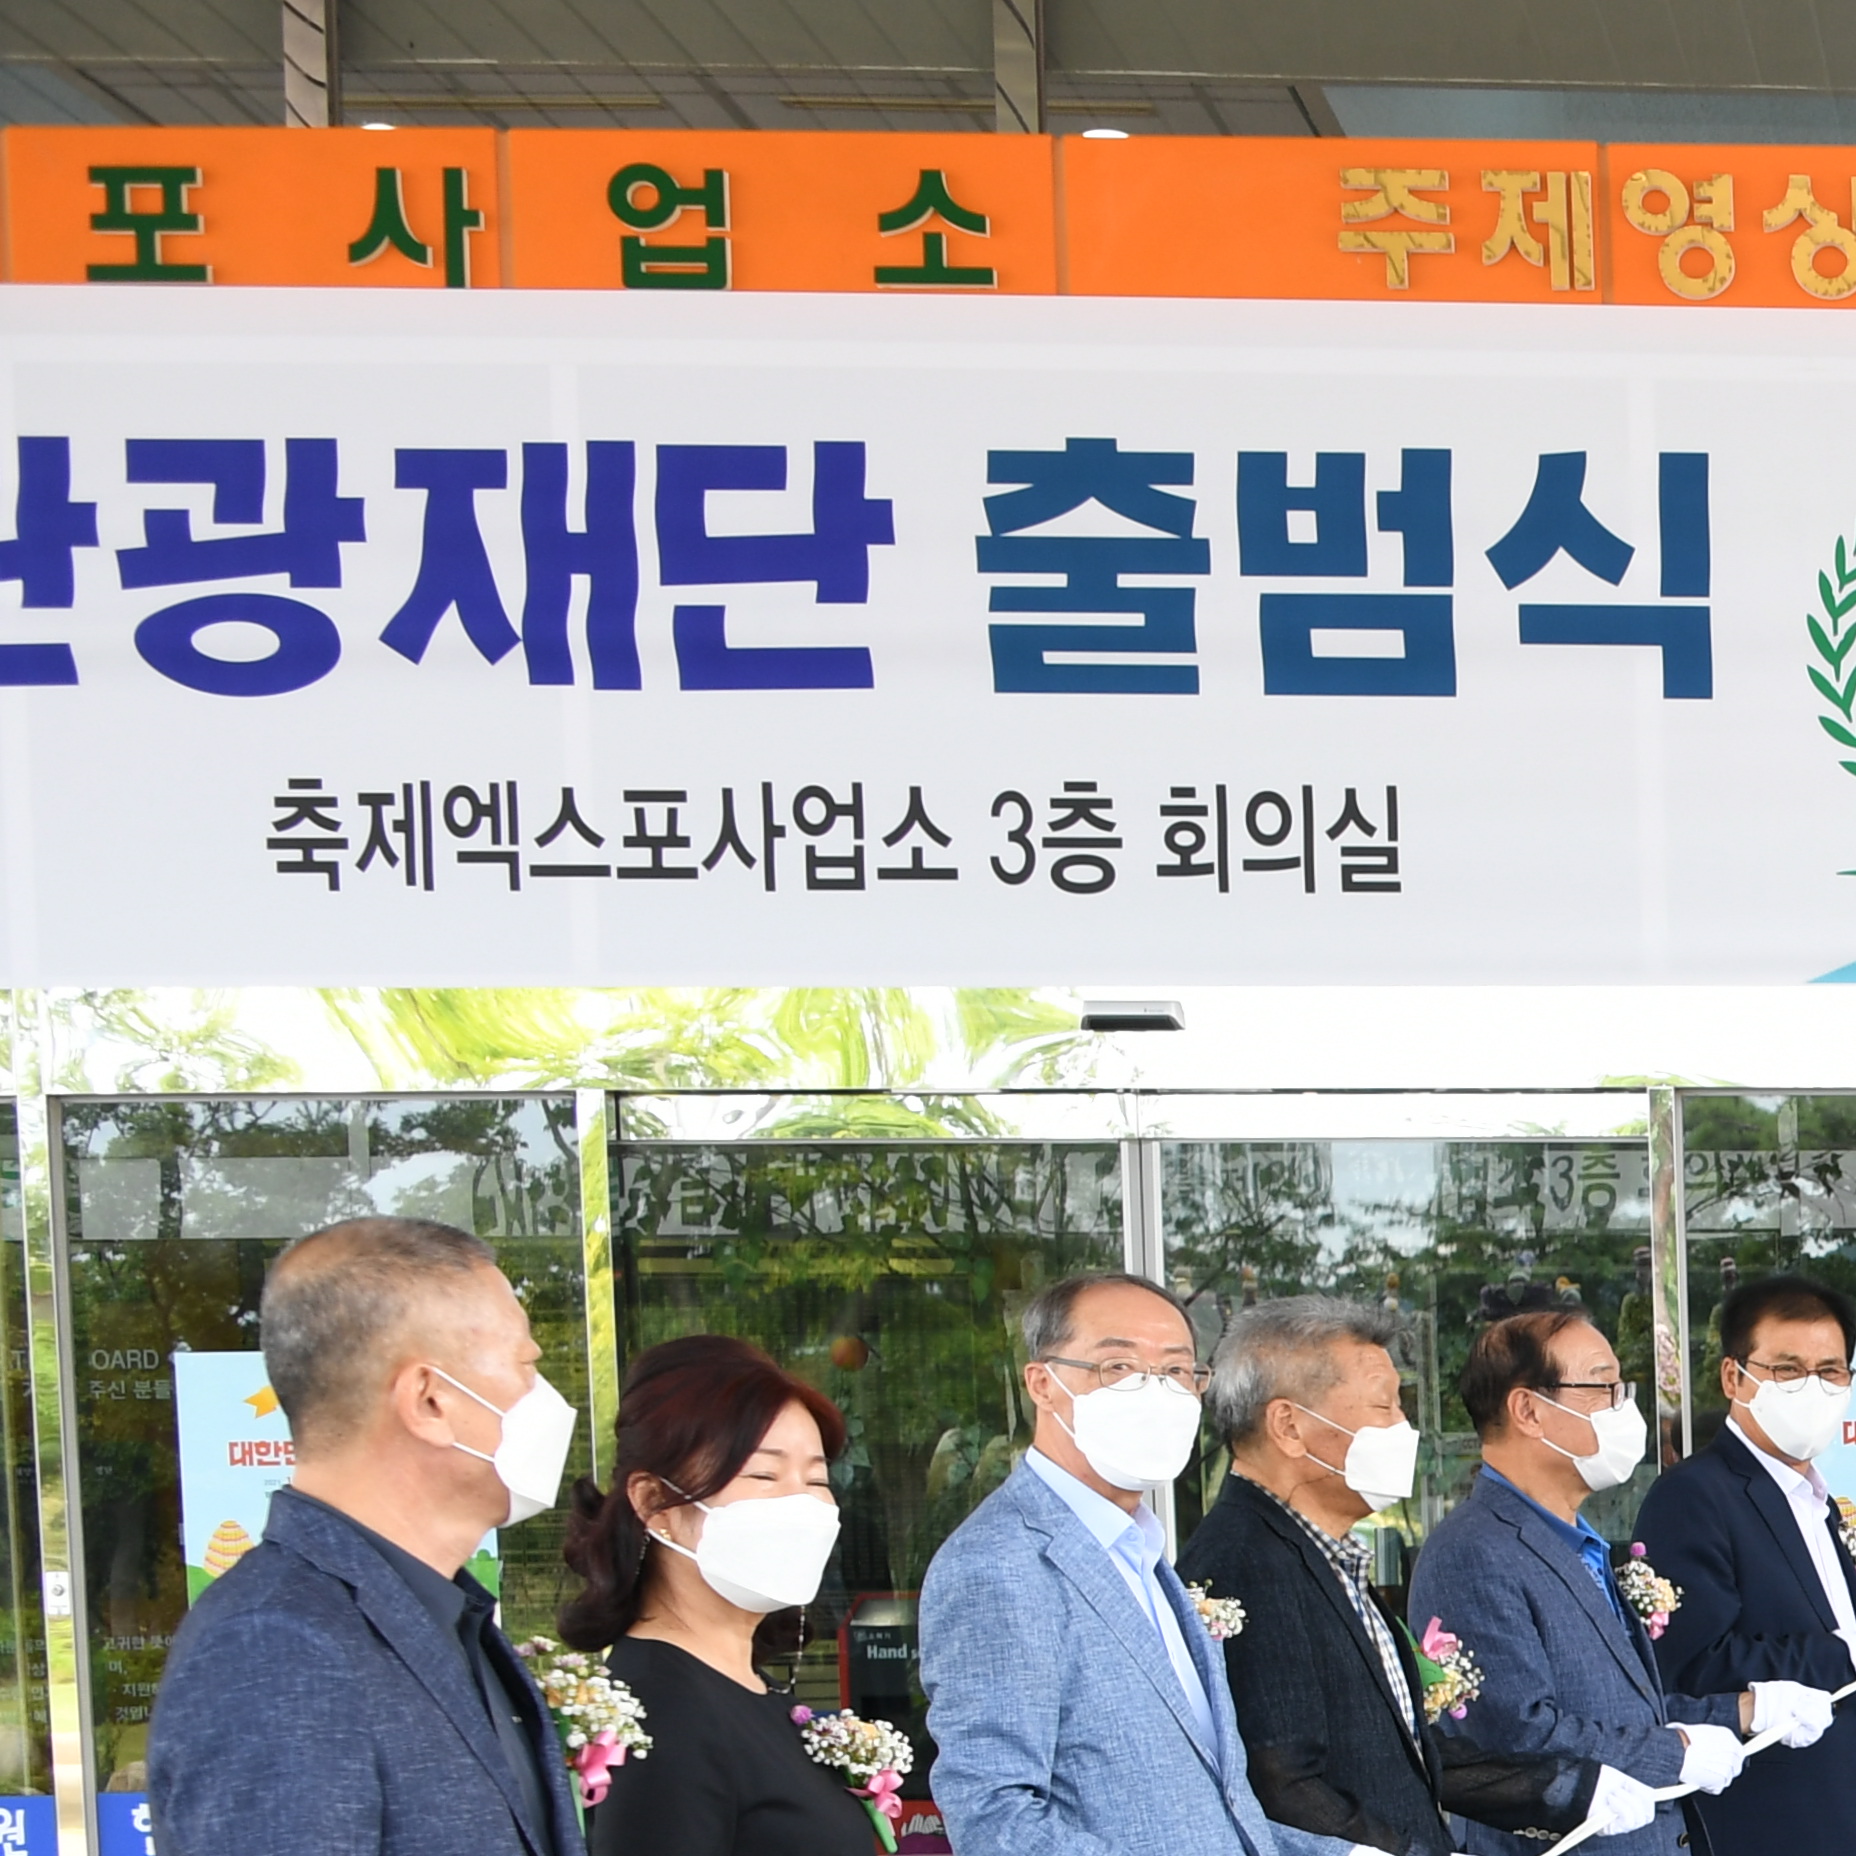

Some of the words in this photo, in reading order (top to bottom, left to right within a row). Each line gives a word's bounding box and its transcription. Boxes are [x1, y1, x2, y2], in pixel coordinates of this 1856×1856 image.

[975, 438, 1714, 700] 출범식
[265, 778, 960, 894] 축제엑스포사업소
[989, 780, 1124, 896] 3층
[1155, 782, 1402, 896] 회의실
[90, 1380, 126, 1400] 주신
[867, 1643, 908, 1660] Hand
